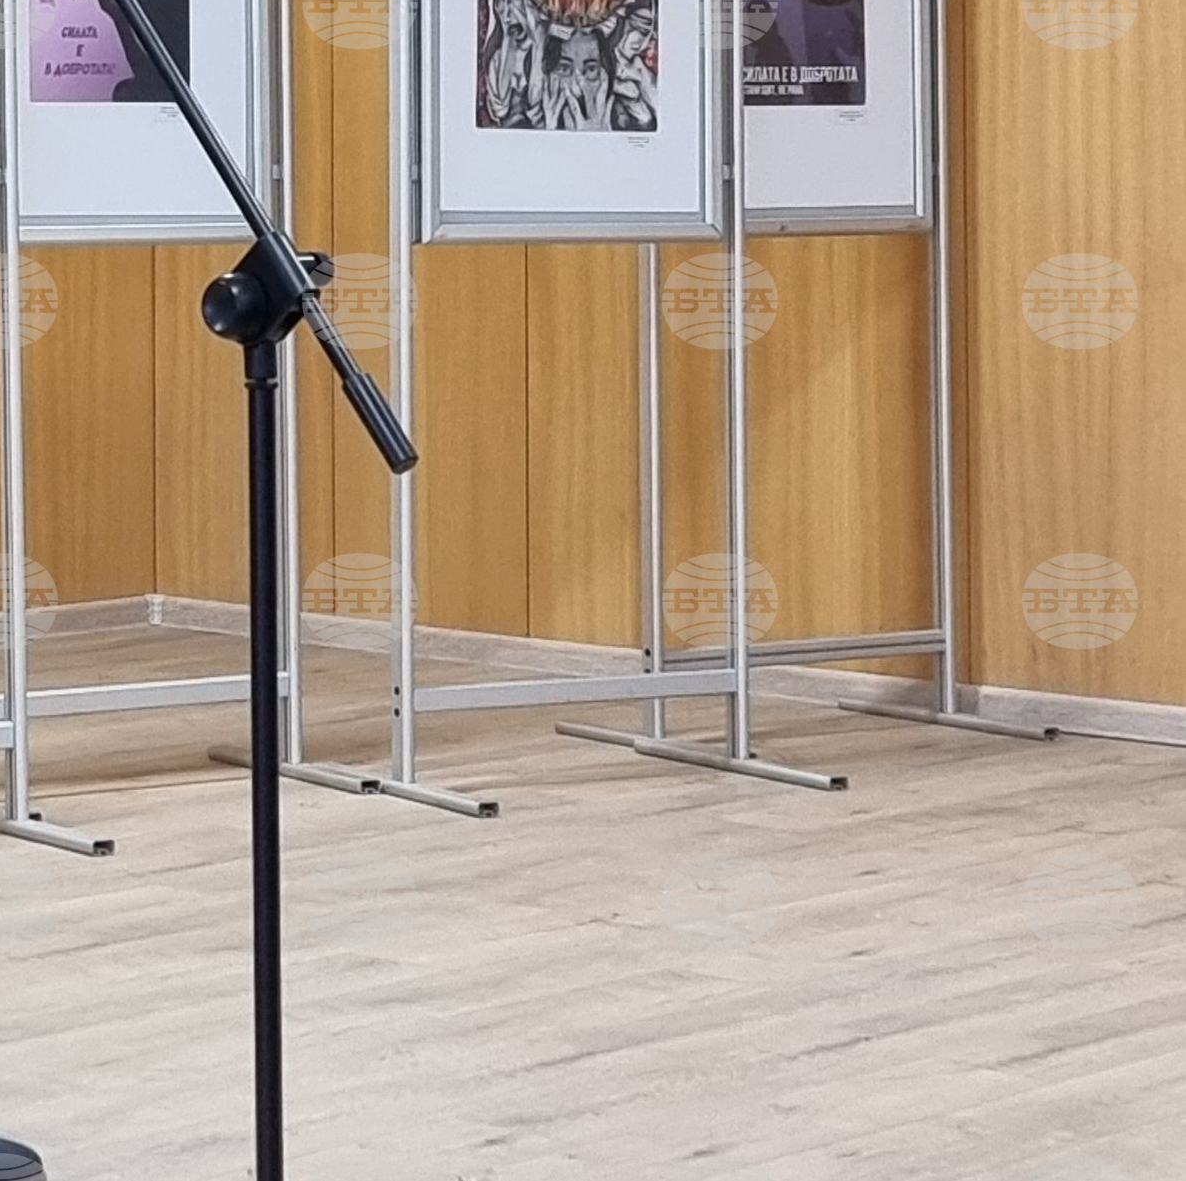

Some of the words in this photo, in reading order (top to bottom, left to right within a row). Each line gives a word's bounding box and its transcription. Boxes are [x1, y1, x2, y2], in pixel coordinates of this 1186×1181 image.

[61, 26, 98, 39] СИЛАТА
[75, 44, 85, 57] Е
[44, 62, 52, 75] В
[782, 66, 789, 82] Е
[790, 66, 798, 82] В
